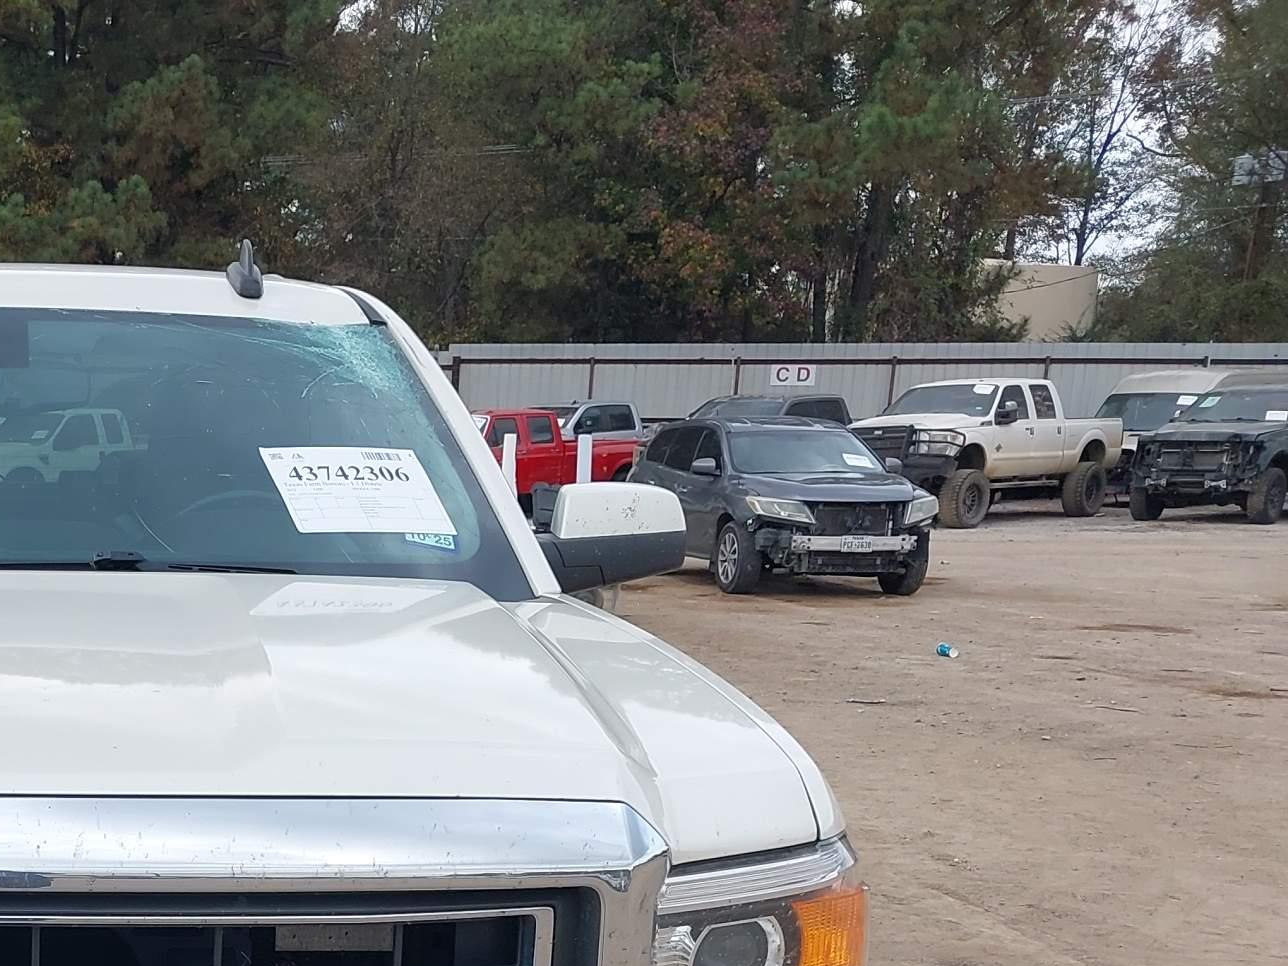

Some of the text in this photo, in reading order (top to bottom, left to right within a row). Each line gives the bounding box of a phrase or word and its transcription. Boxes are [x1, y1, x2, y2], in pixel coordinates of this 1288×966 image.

[776, 366, 810, 382] C D
[288, 465, 410, 482] 43742306
[434, 535, 452, 547] 25
